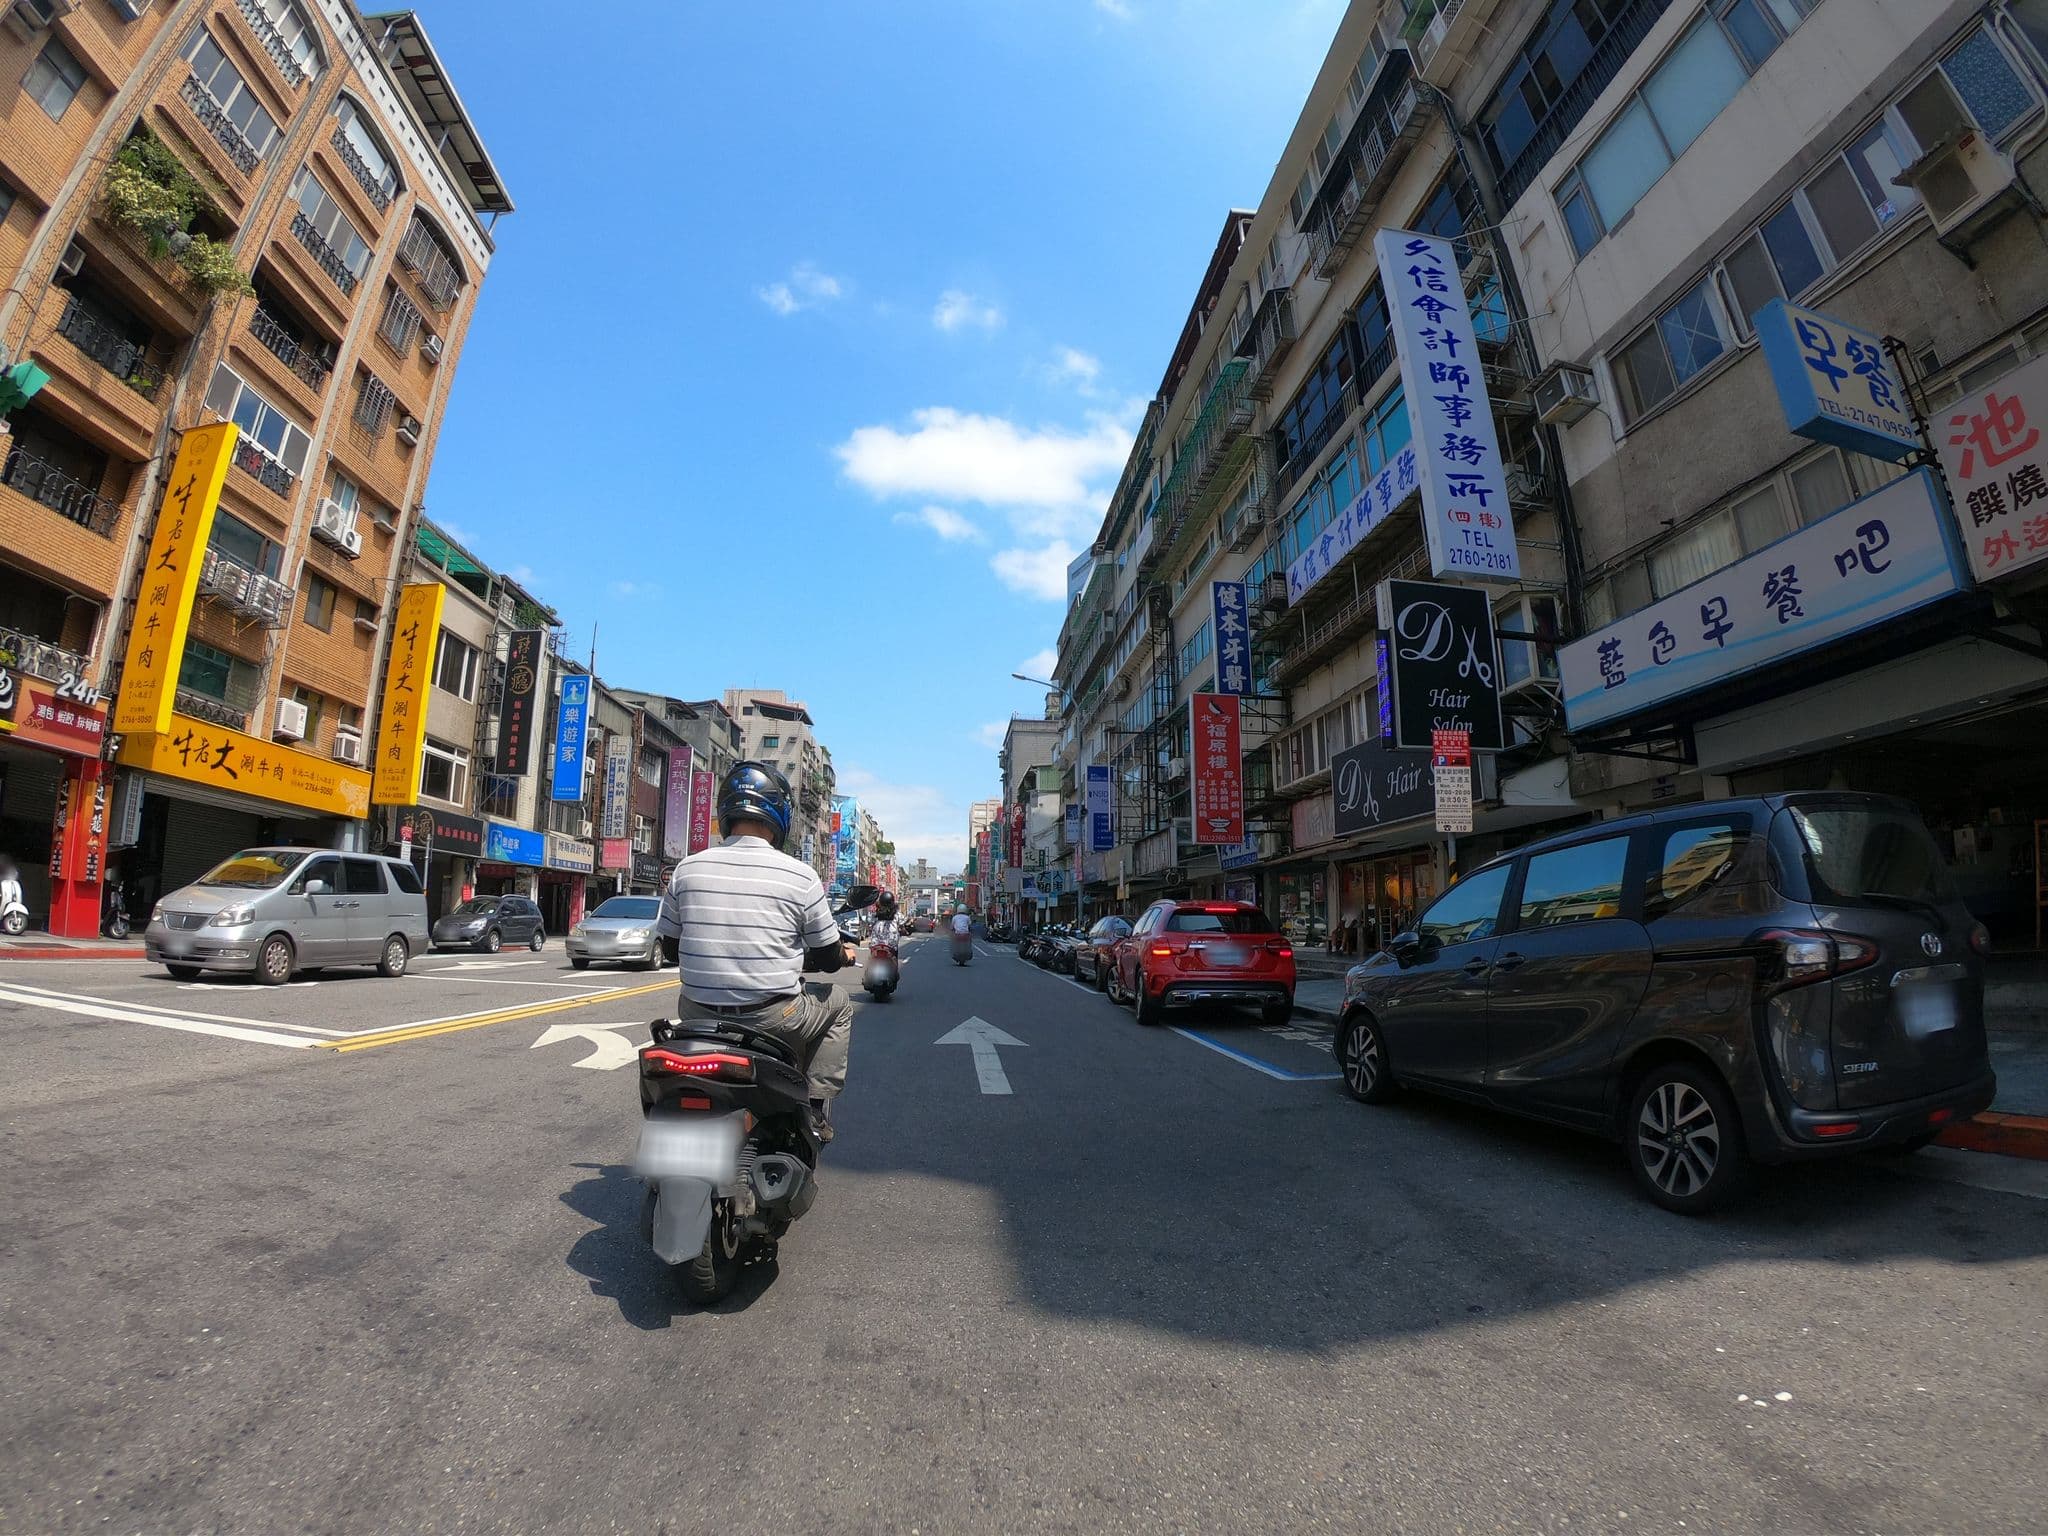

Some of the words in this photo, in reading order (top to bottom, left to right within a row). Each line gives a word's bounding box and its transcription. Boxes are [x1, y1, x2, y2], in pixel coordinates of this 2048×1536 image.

[1404, 239, 1494, 507] 久信會計師事務所
[1795, 317, 1900, 413] 早餐
[1949, 392, 2040, 479] 池
[1462, 529, 1494, 548] TEL
[1450, 548, 1512, 570] 2760-2181
[1597, 519, 1893, 690] 藍色早餐吧
[56, 672, 100, 706] 24H
[1428, 688, 1472, 709] Hair
[1387, 761, 1422, 799] Hair
